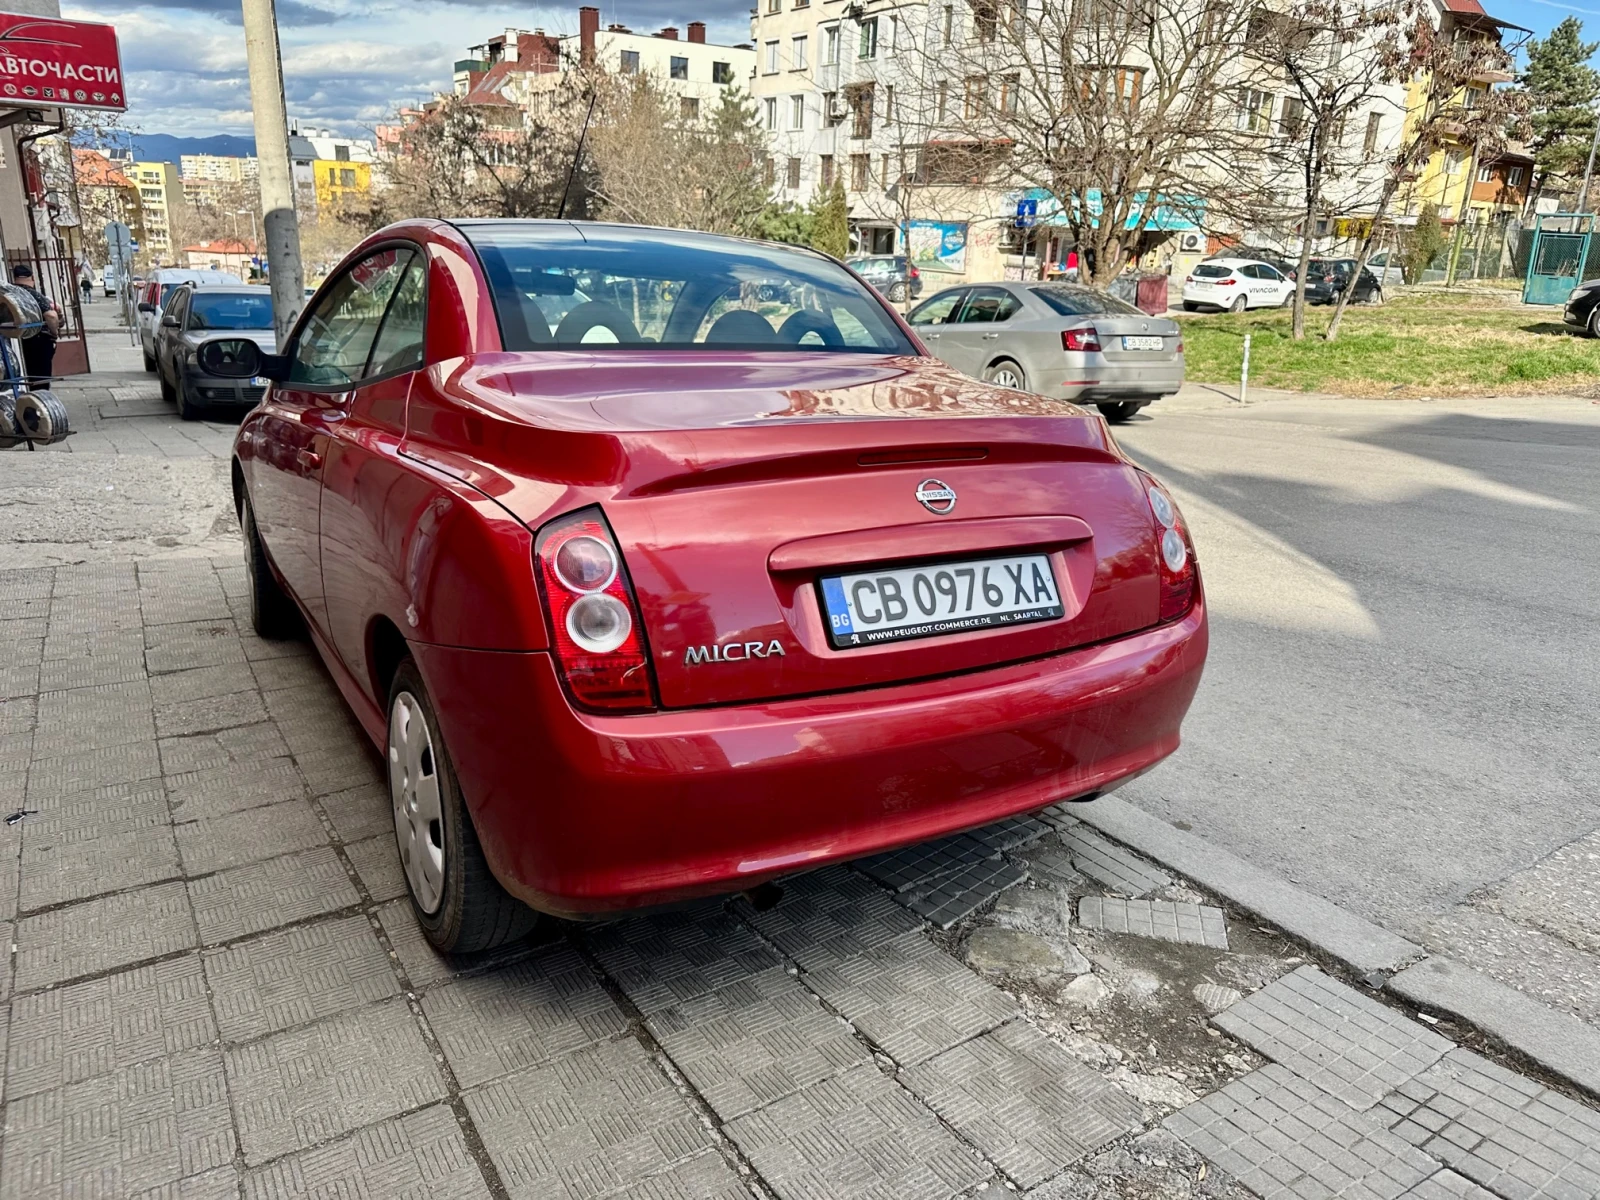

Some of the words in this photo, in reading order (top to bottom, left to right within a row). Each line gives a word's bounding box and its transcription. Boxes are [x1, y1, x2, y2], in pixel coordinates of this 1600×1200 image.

[922, 491, 954, 499] NISSAN
[852, 577, 908, 625] CB
[913, 566, 1004, 617] 0976
[1003, 562, 1053, 605] XA
[831, 613, 850, 628] BG
[866, 616, 992, 641] WWW.PEUGEOT-COMMERCE.DE
[1013, 610, 1043, 620] SAARTAL
[684, 639, 786, 665] MICRA
